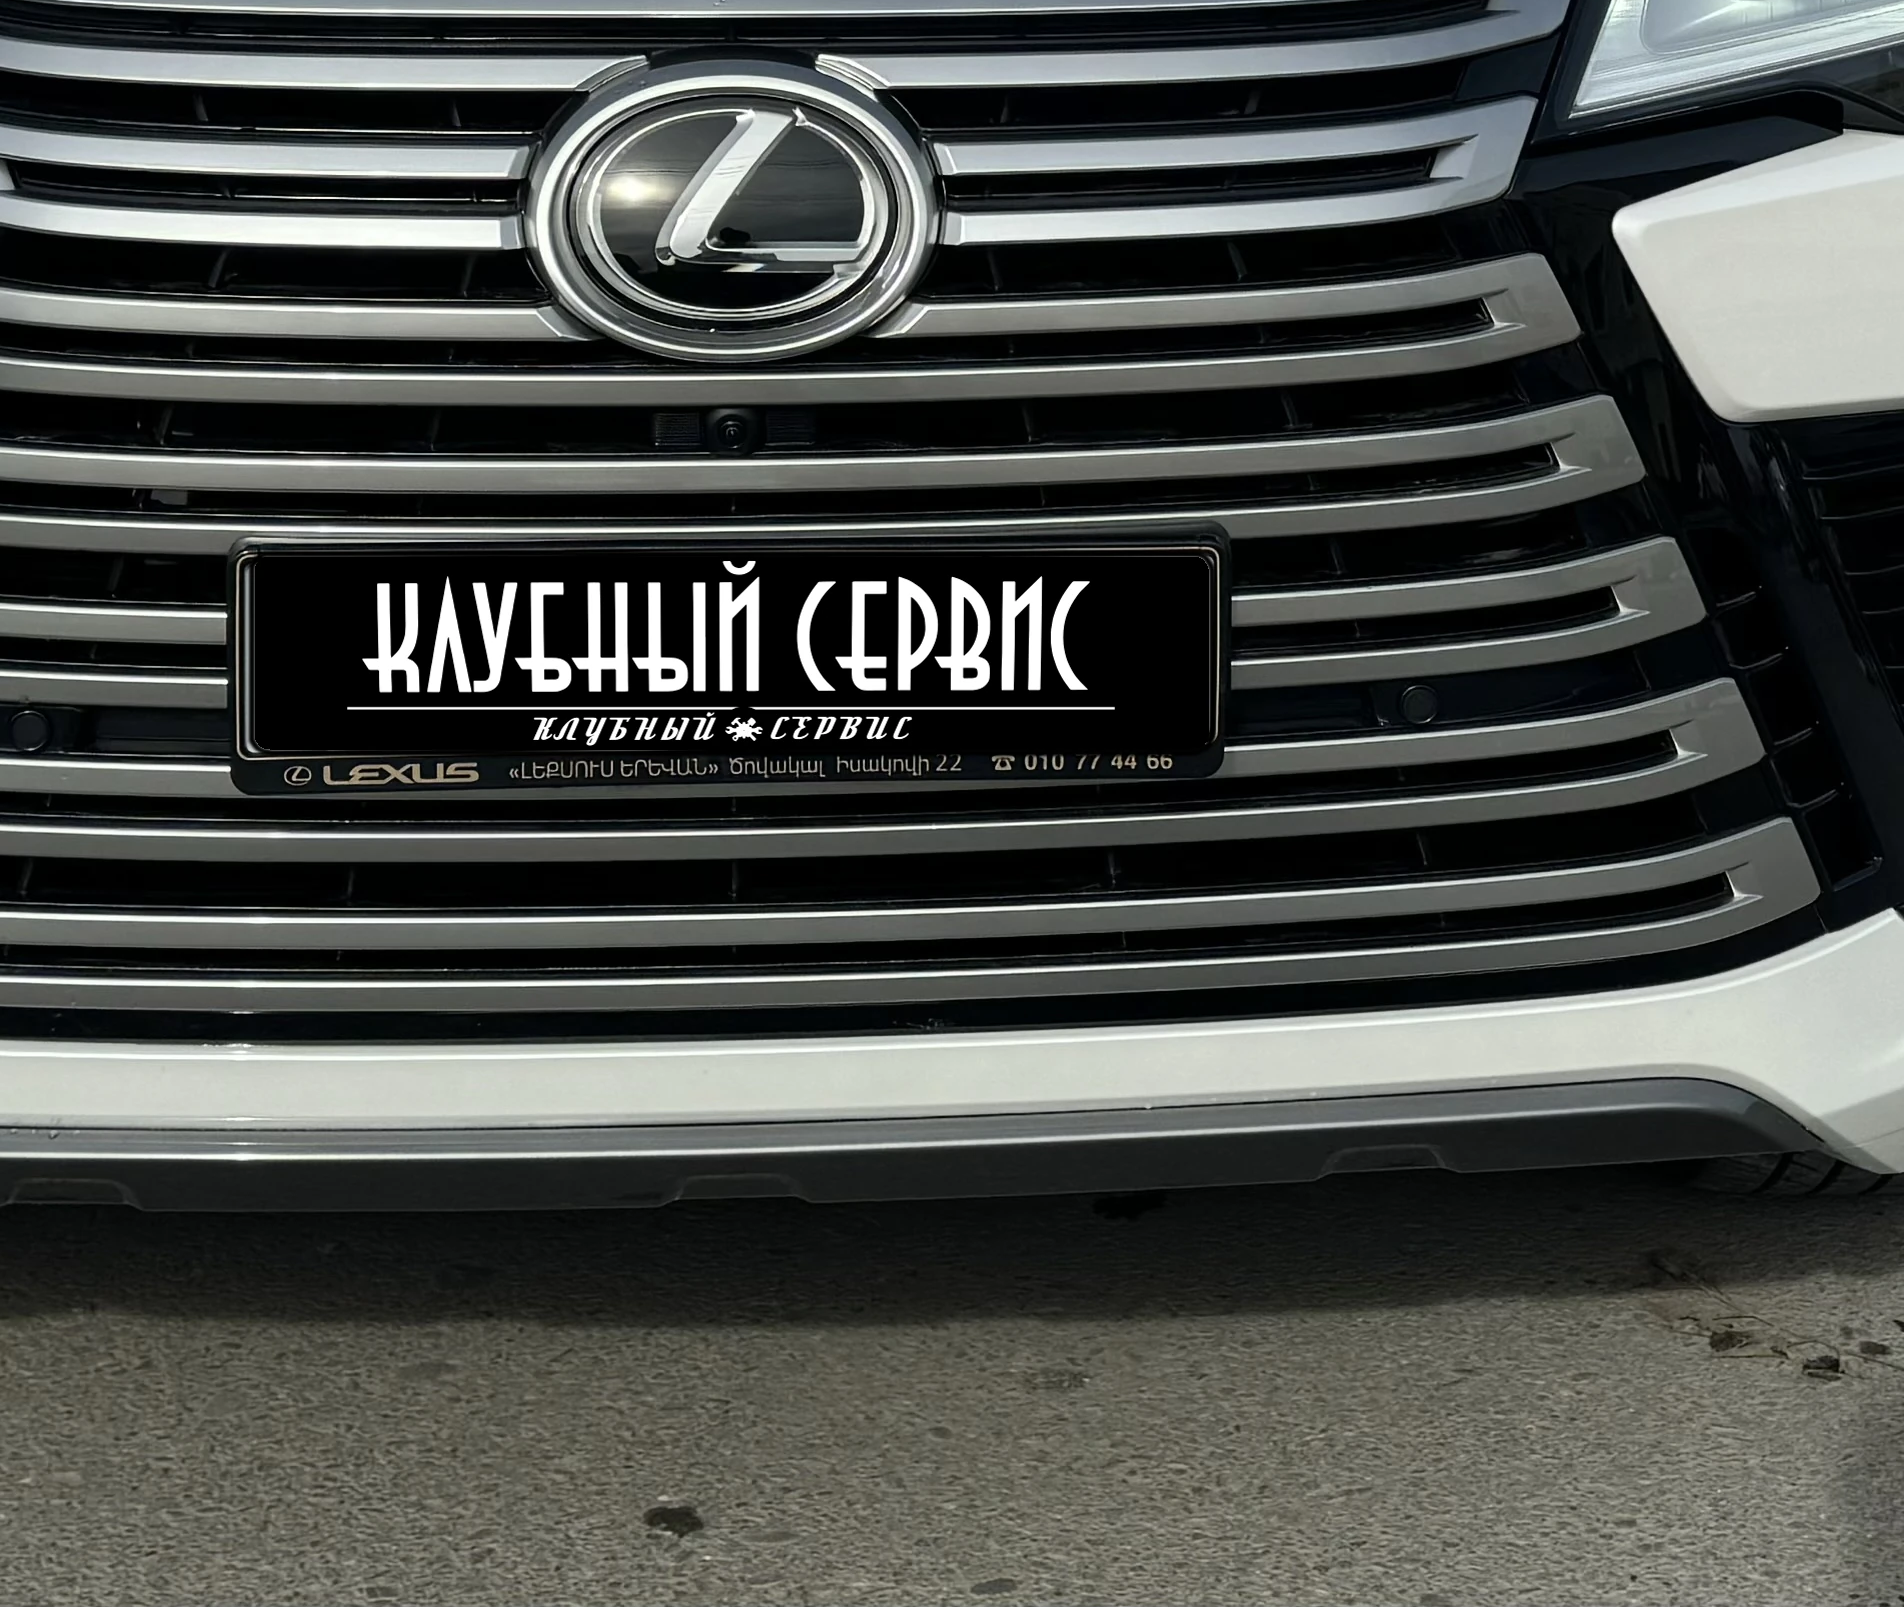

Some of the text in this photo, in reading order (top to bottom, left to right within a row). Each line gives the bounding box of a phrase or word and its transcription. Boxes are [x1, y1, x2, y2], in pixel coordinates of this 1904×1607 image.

[935, 754, 963, 772] 22
[1023, 754, 1065, 771] 010
[1075, 754, 1101, 771] 77
[1110, 754, 1138, 770] 44
[1146, 754, 1174, 770] 66
[322, 762, 480, 786] LEXUS
